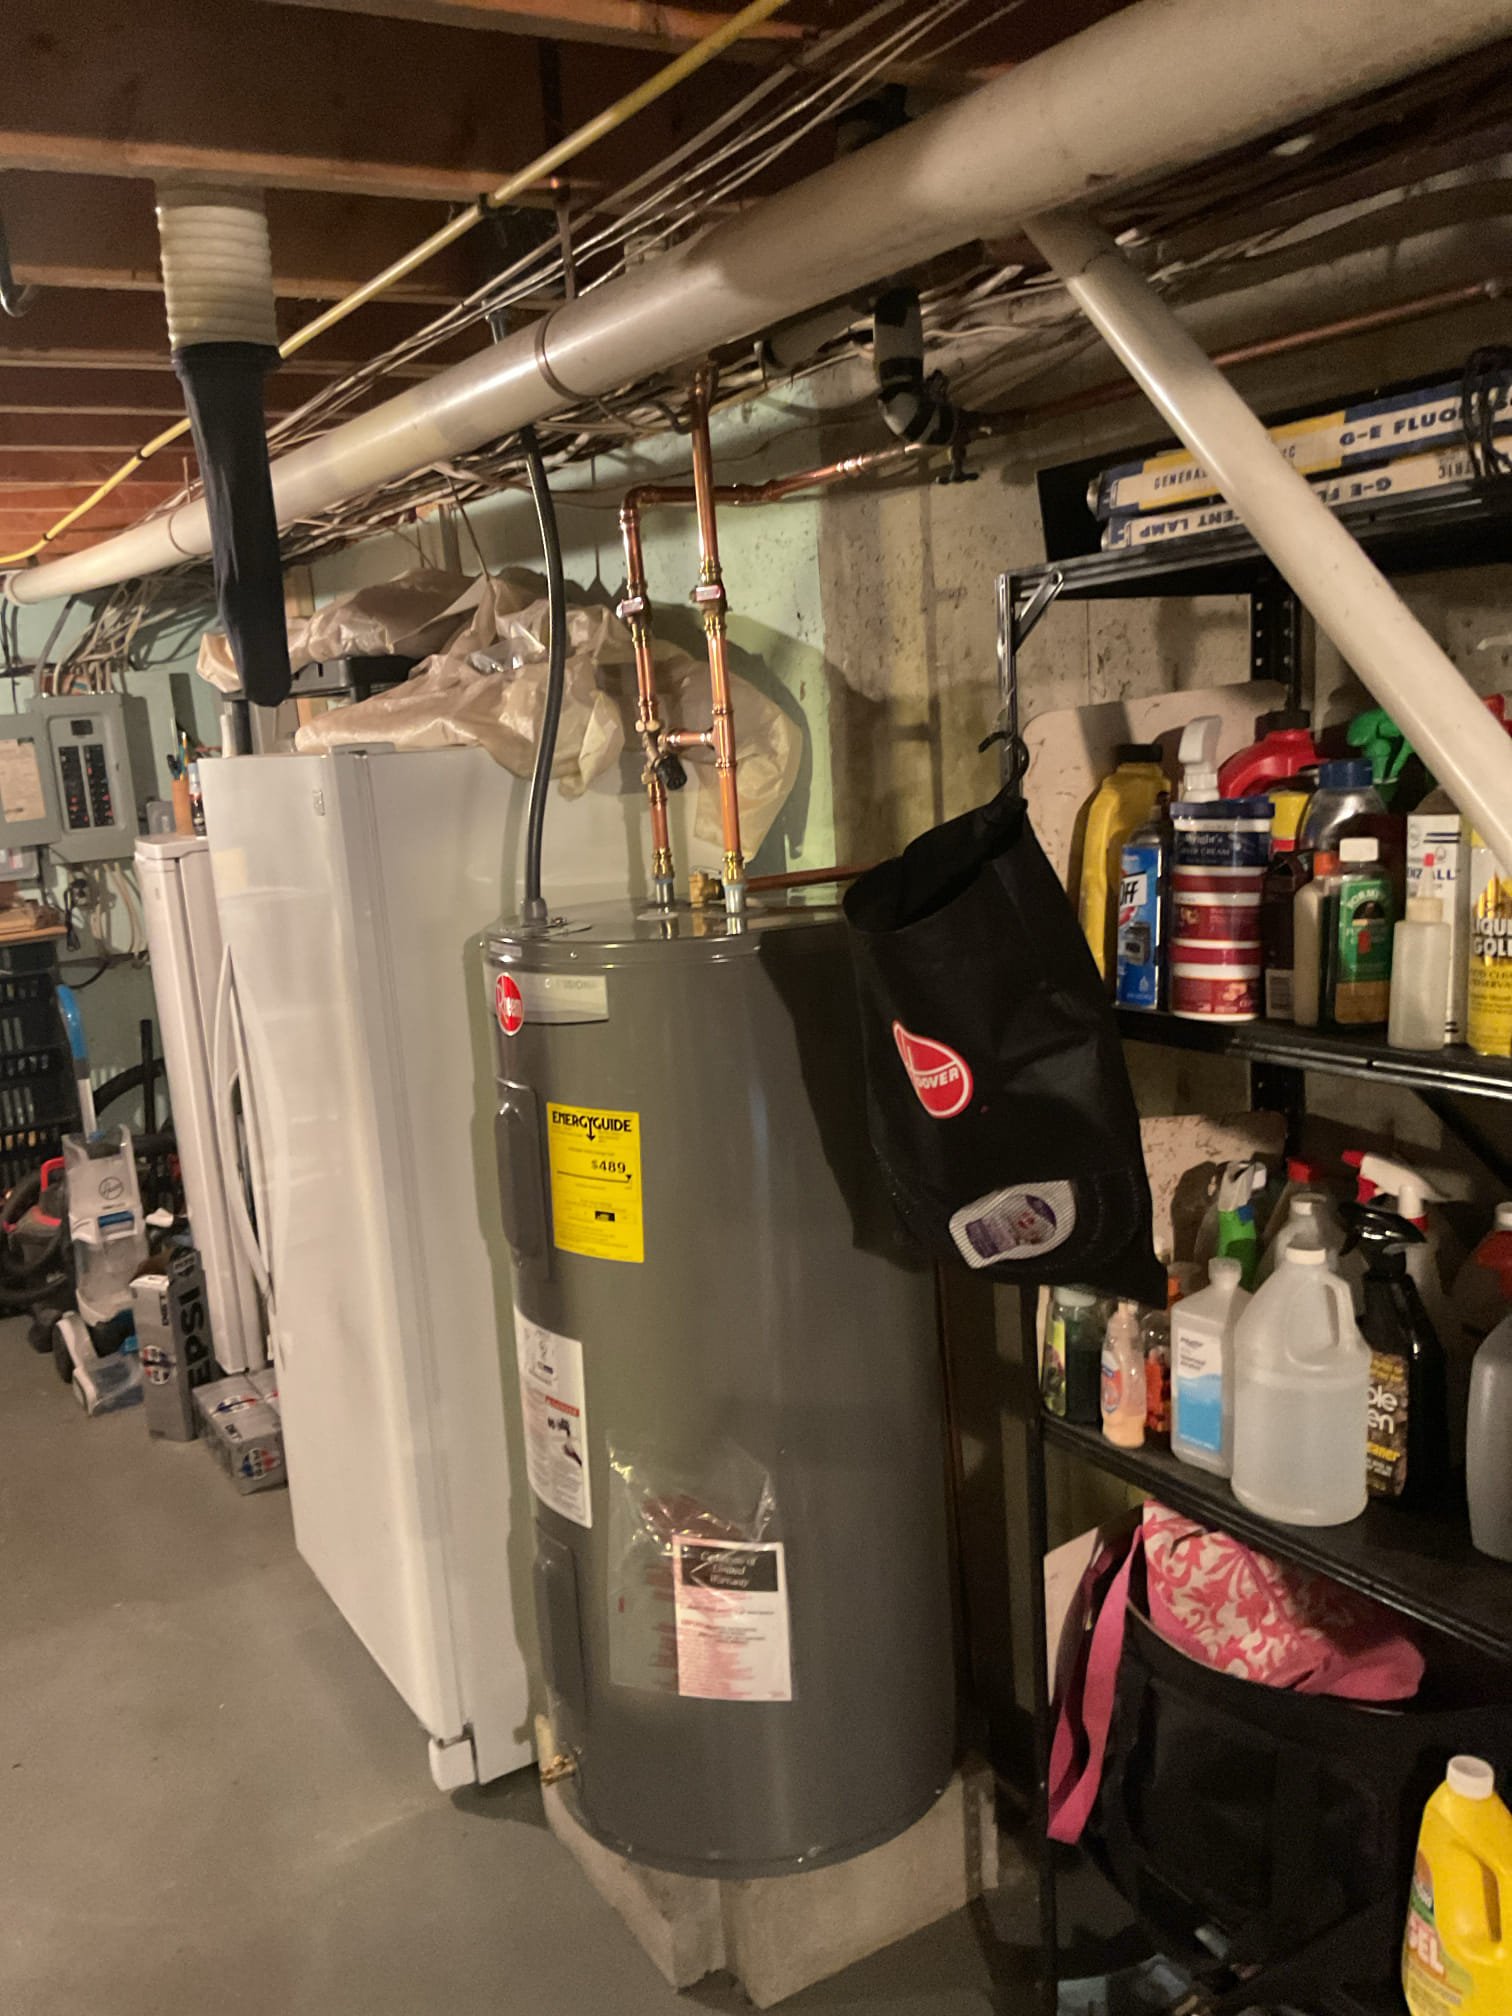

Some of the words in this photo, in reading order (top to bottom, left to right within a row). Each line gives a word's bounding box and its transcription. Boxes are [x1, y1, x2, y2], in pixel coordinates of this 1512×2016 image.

[1340, 424, 1382, 447] G-E
[1393, 404, 1467, 436] FLUO
[1139, 518, 1190, 540] LAMP
[1197, 508, 1242, 529] ENT
[551, 1110, 633, 1134] ENERGYGUIDE
[591, 1159, 627, 1175] $489
[177, 1286, 214, 1387] EPSI
